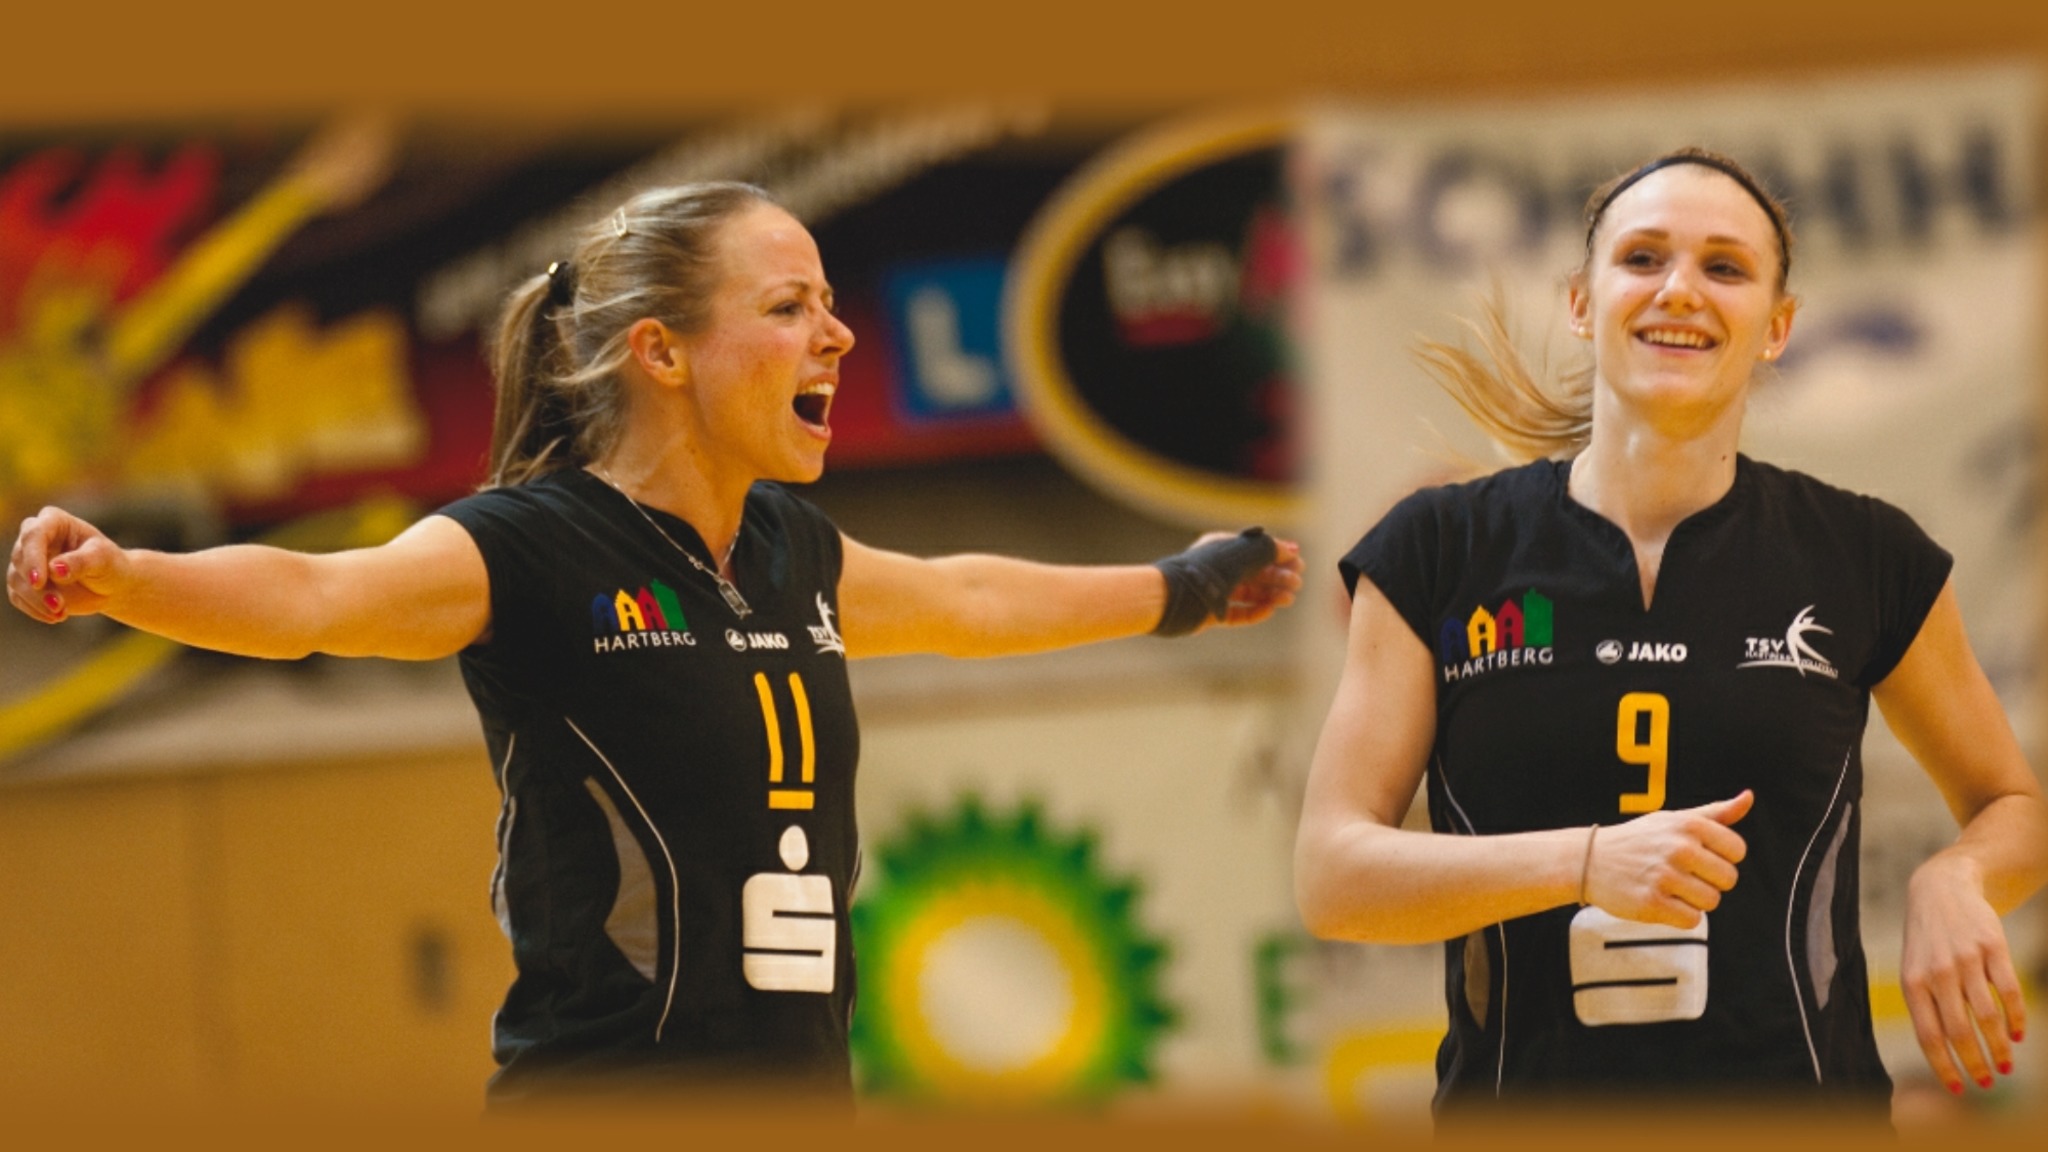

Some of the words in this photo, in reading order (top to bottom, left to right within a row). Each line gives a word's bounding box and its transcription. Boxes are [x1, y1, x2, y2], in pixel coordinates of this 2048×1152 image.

[594, 631, 697, 653] HARTBERG
[747, 631, 789, 650] JAKO
[1627, 641, 1688, 662] JAKO
[1745, 637, 1785, 653] TSV
[1444, 647, 1554, 682] HARTBERG
[753, 672, 815, 783] 11
[1616, 691, 1671, 814] 9
